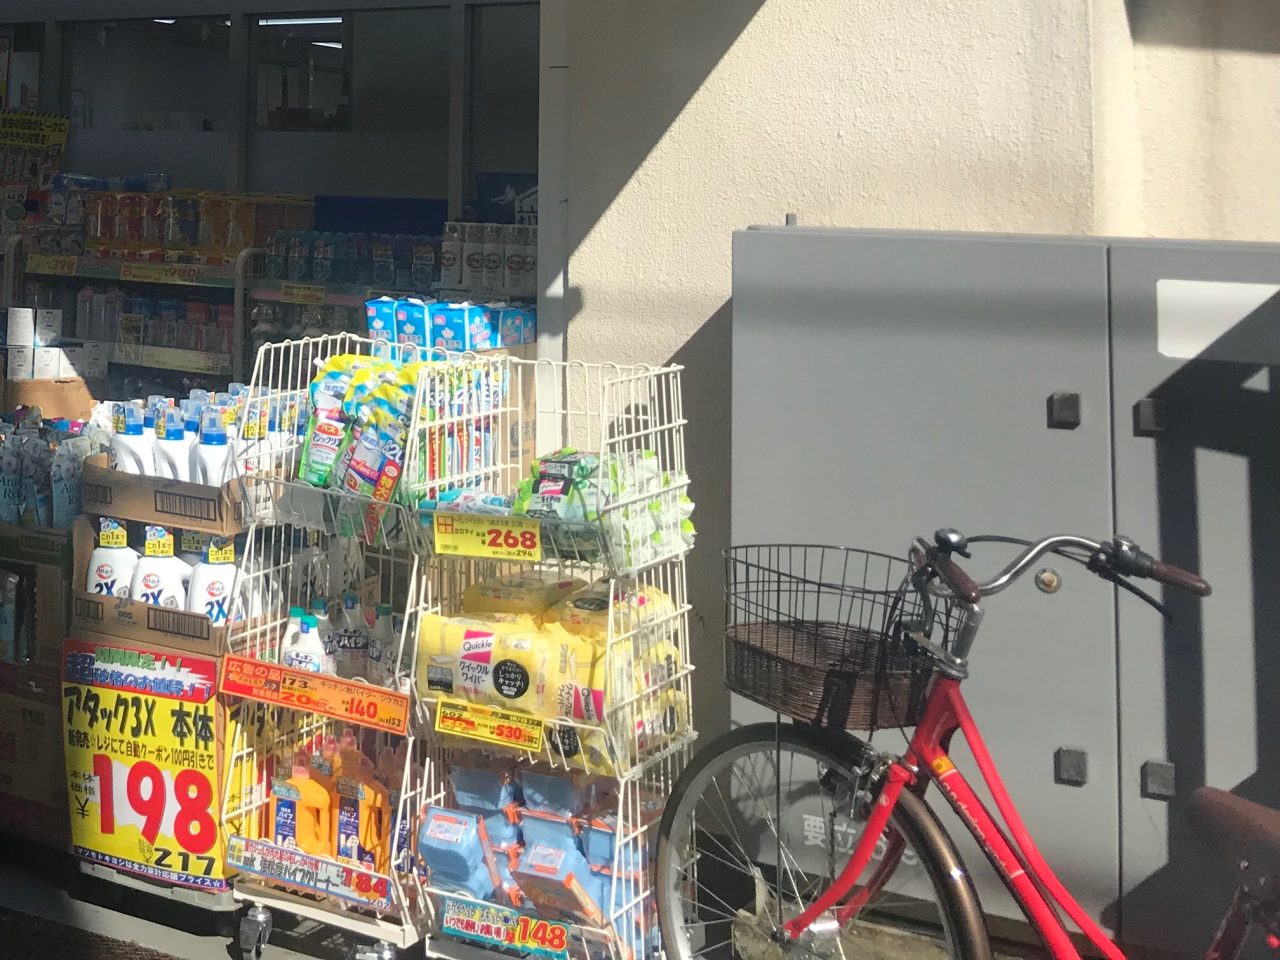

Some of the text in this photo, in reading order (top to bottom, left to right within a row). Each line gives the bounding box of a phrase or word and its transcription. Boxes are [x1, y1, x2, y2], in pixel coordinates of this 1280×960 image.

[487, 528, 537, 549] 268
[463, 639, 493, 651] Quickle
[227, 661, 281, 681] 広告の品
[459, 661, 490, 676] クイックル
[461, 672, 486, 685] ワイパー
[499, 669, 522, 680] しっかり
[282, 676, 309, 689] 173
[348, 697, 378, 719] 140
[582, 688, 594, 721] Quickle
[64, 686, 157, 739] アタック3X
[171, 701, 215, 751] 本体
[495, 725, 522, 740] 530
[75, 754, 218, 854] ¥ 198
[154, 846, 216, 876] 217
[342, 866, 388, 898] 184
[519, 916, 567, 951] 148
